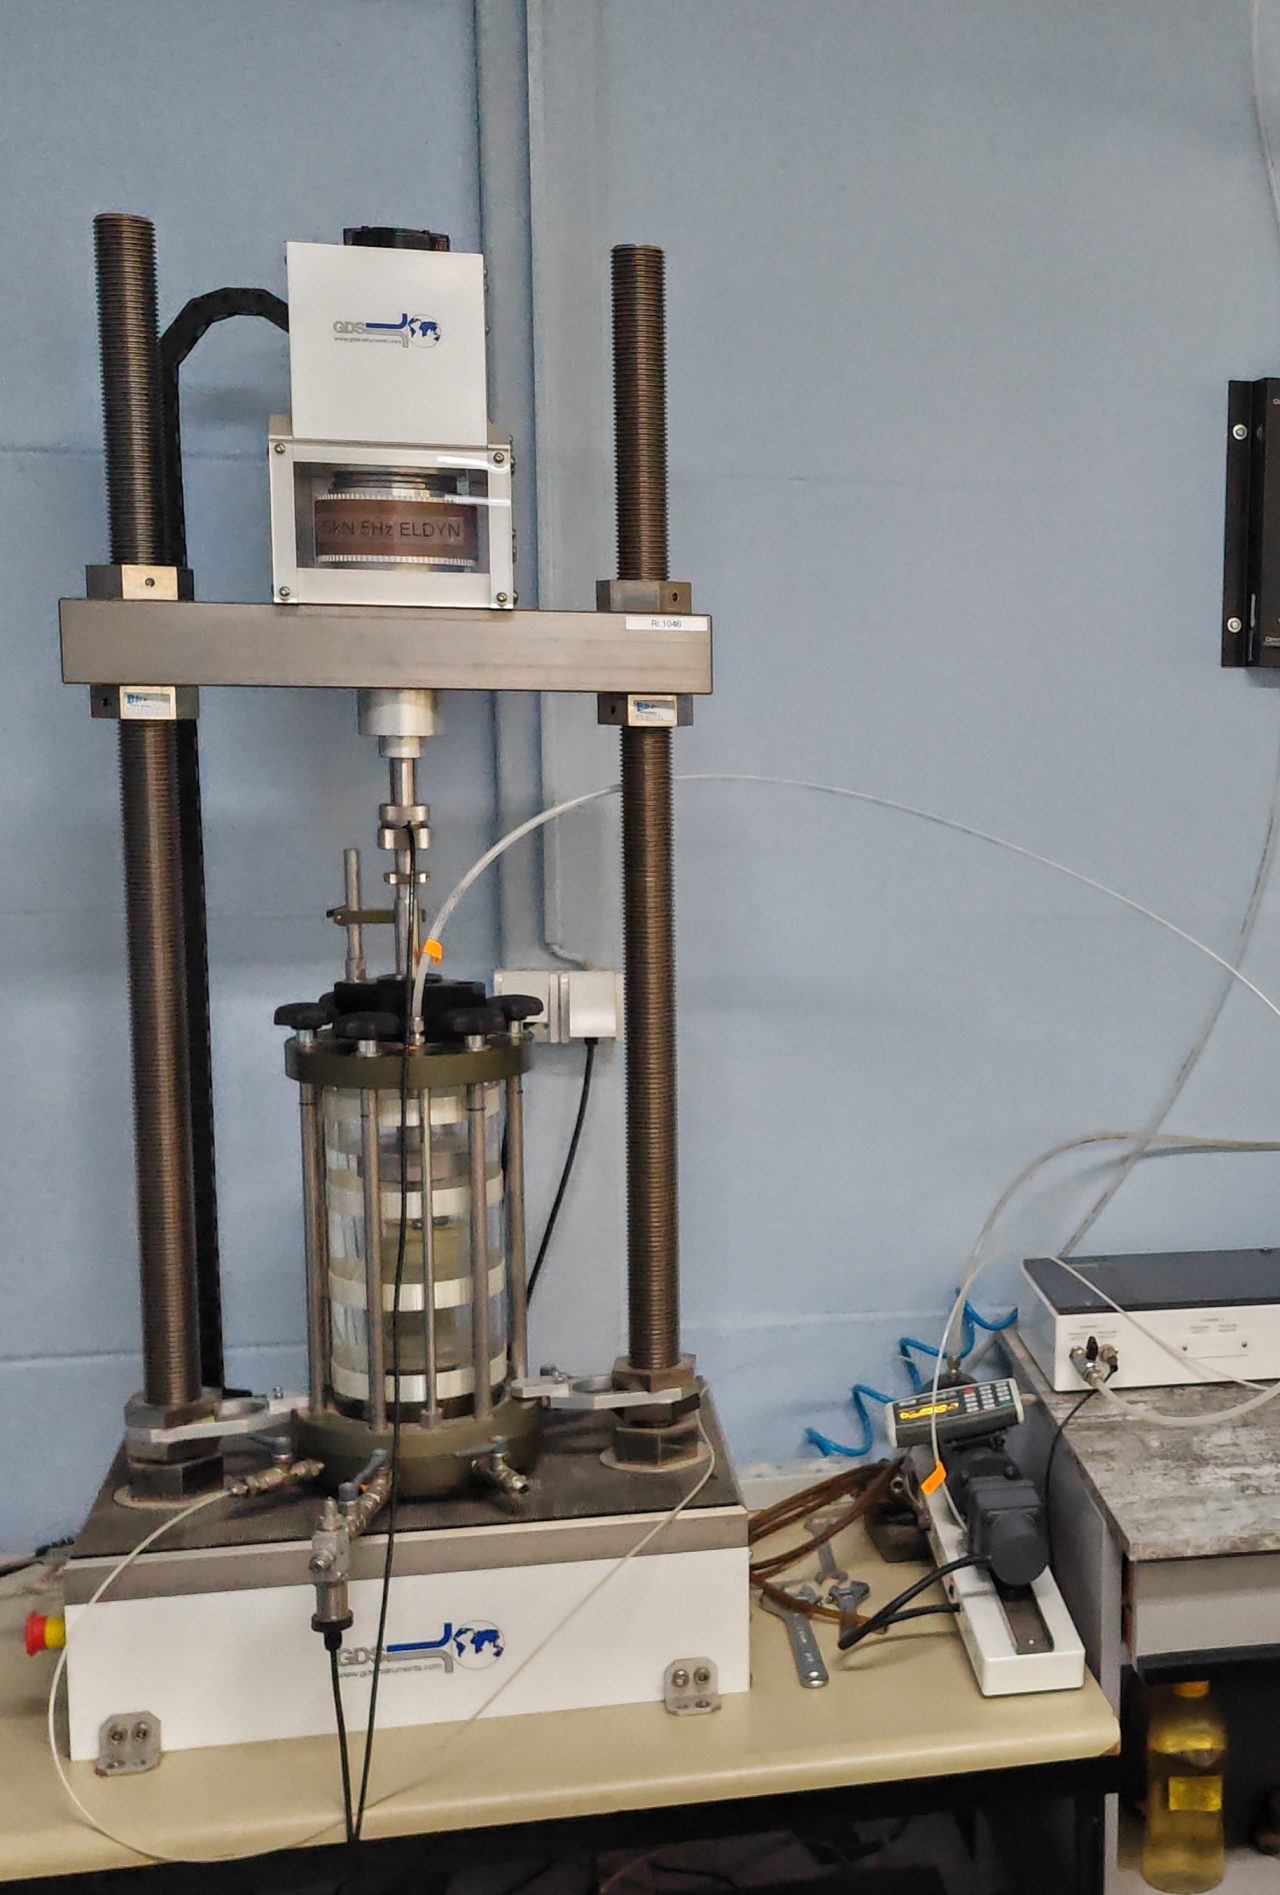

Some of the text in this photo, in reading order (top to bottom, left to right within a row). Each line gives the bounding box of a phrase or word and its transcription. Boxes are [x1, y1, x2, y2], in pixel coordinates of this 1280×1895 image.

[333, 320, 365, 334] GDS
[400, 521, 462, 539] ELDYN
[663, 620, 682, 628] 1046
